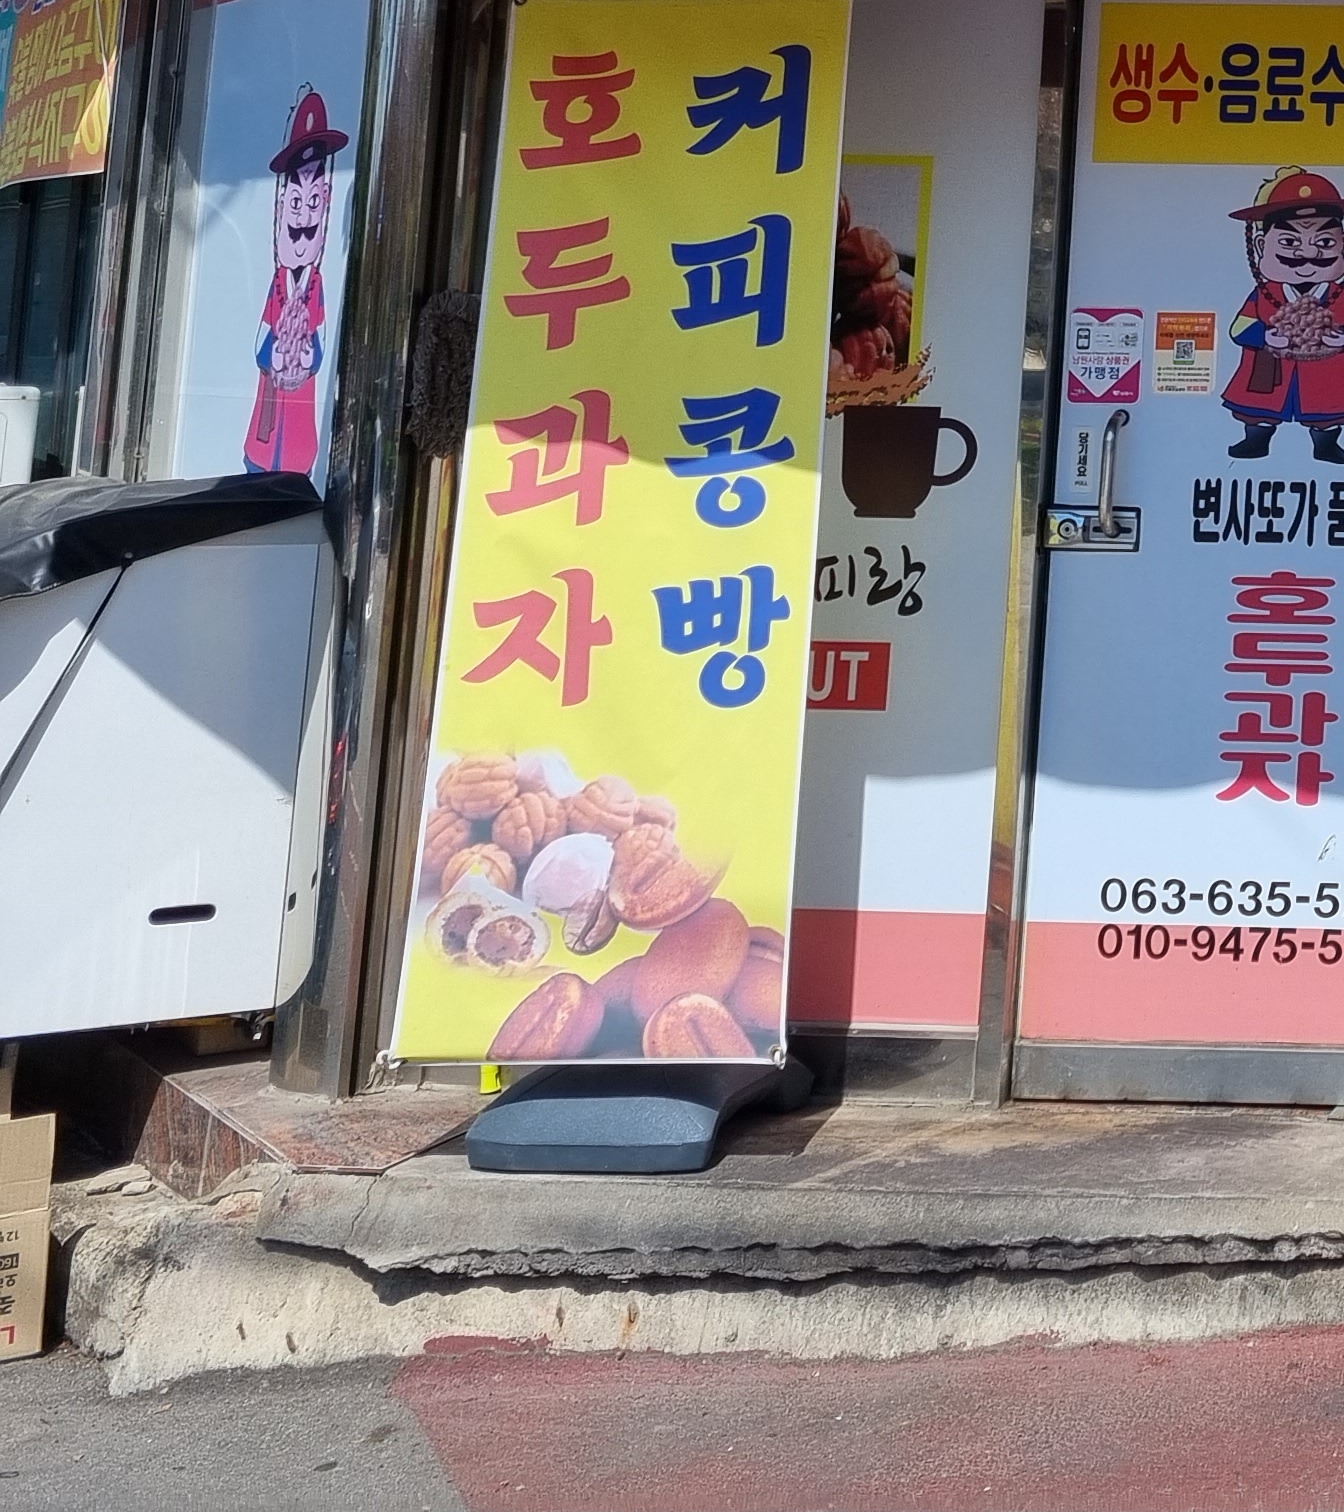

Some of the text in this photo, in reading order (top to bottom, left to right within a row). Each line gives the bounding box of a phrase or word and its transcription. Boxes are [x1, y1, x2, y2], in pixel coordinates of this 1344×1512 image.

[460, 50, 642, 708] 호두과자
[651, 44, 812, 709] 커피콩빵
[1080, 366, 1121, 379] 가맹점
[1106, 355, 1130, 366] 상품권
[1076, 431, 1089, 477] 당기세요
[1193, 477, 1319, 546] 변사또가
[814, 545, 927, 617] 피랑
[809, 650, 869, 702] UT
[1215, 570, 1339, 807] 호두과자
